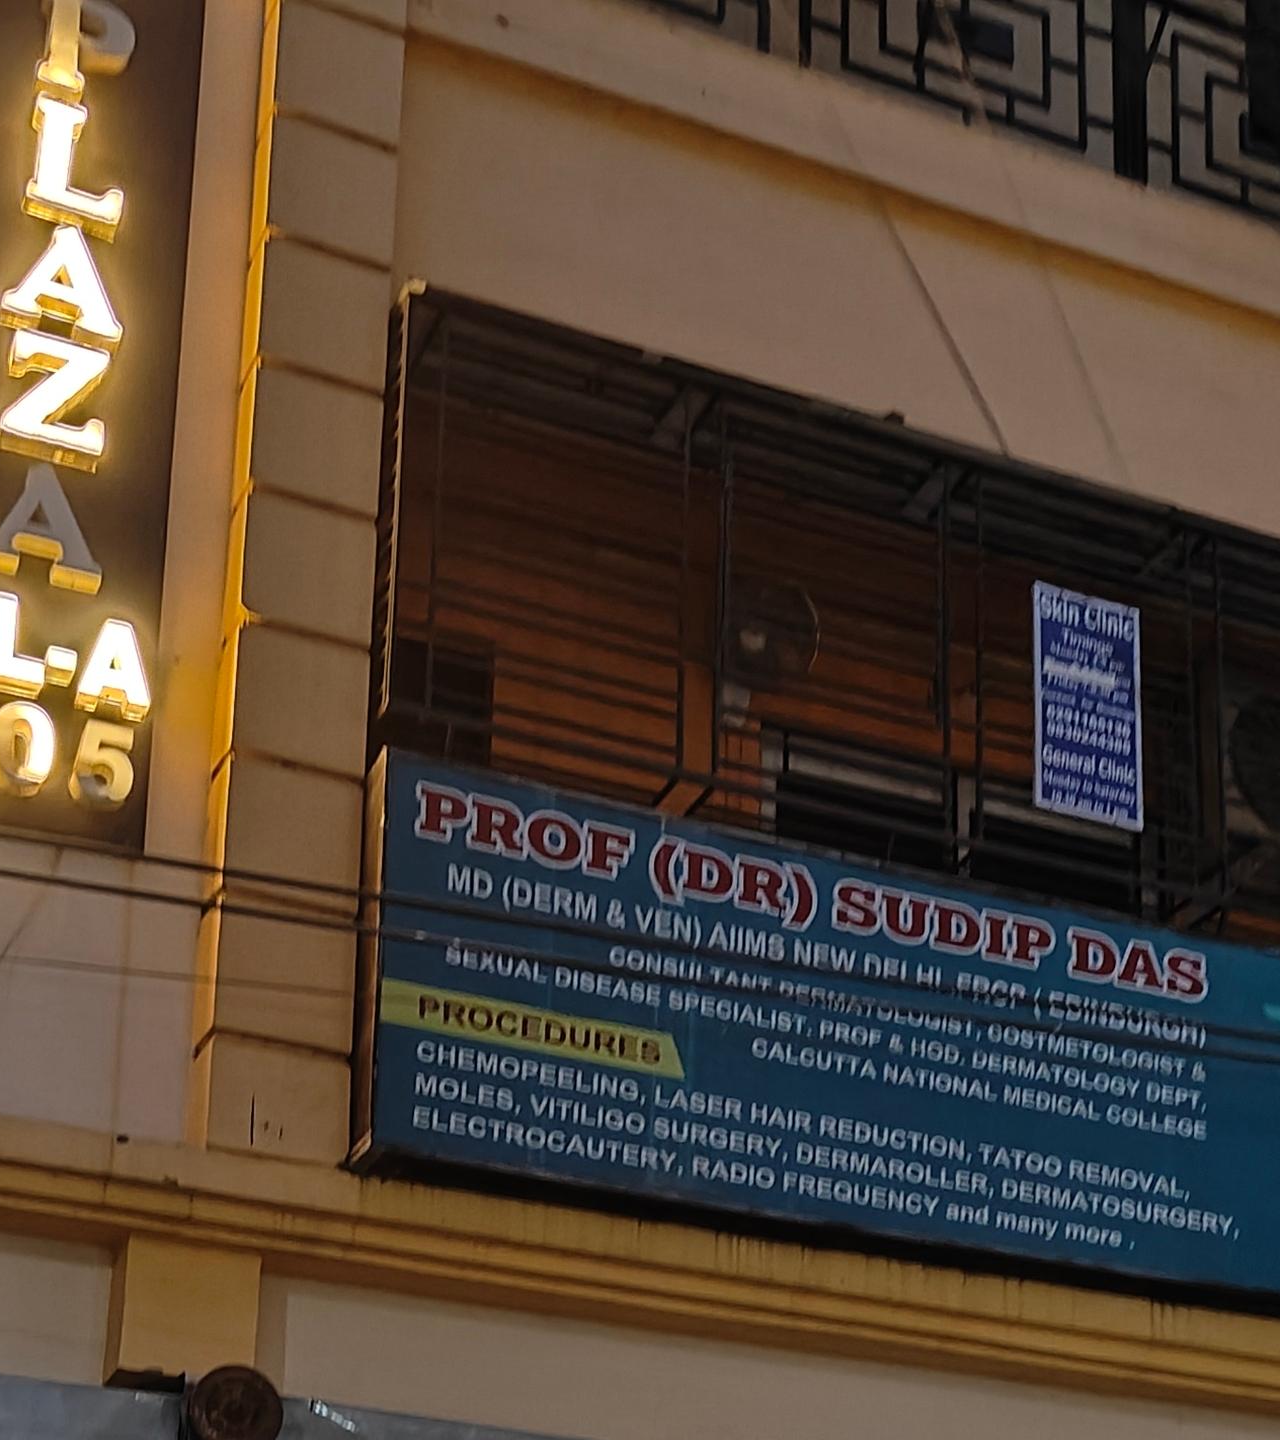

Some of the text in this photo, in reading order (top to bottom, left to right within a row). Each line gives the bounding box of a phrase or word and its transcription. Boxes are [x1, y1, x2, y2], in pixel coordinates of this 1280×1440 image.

[1040, 592, 1134, 642] Skin Clinic
[1042, 744, 1135, 787] General Clinic
[415, 780, 1209, 1004] PROF (DR) SUDIP DAS
[447, 863, 493, 899] MD
[503, 875, 597, 923] (DERM
[606, 899, 626, 930] &
[635, 905, 701, 949] VEN)
[708, 921, 785, 961] AIIMS
[793, 939, 857, 973] NEW
[418, 995, 662, 1065] PROCEDURES
[445, 945, 547, 983] SEXUAL
[555, 966, 661, 1007] DISEASE
[668, 988, 813, 1038] SPECIALIST,
[819, 1019, 883, 1048] PROF
[972, 1050, 1140, 1096] DERMATOLOGY
[416, 1040, 1191, 1203] CHEMOPEELING, LASER HAIR REDUCTION, TATOO REMOVAL,
[752, 1037, 1207, 1141] CALCUTTA NATIONAL MEDICAL COLLEGE
[412, 1105, 684, 1177] ELECTROCAUTERY,
[692, 1155, 775, 1190] RADIO
[782, 1171, 940, 1217] FREQUENCY
[946, 1202, 989, 1226] and
[996, 1209, 1059, 1242] many
[414, 1071, 1241, 1241] MOLES, VITILIGO SURGERY, DERMAROLLER, DERMATOSURGERY,
